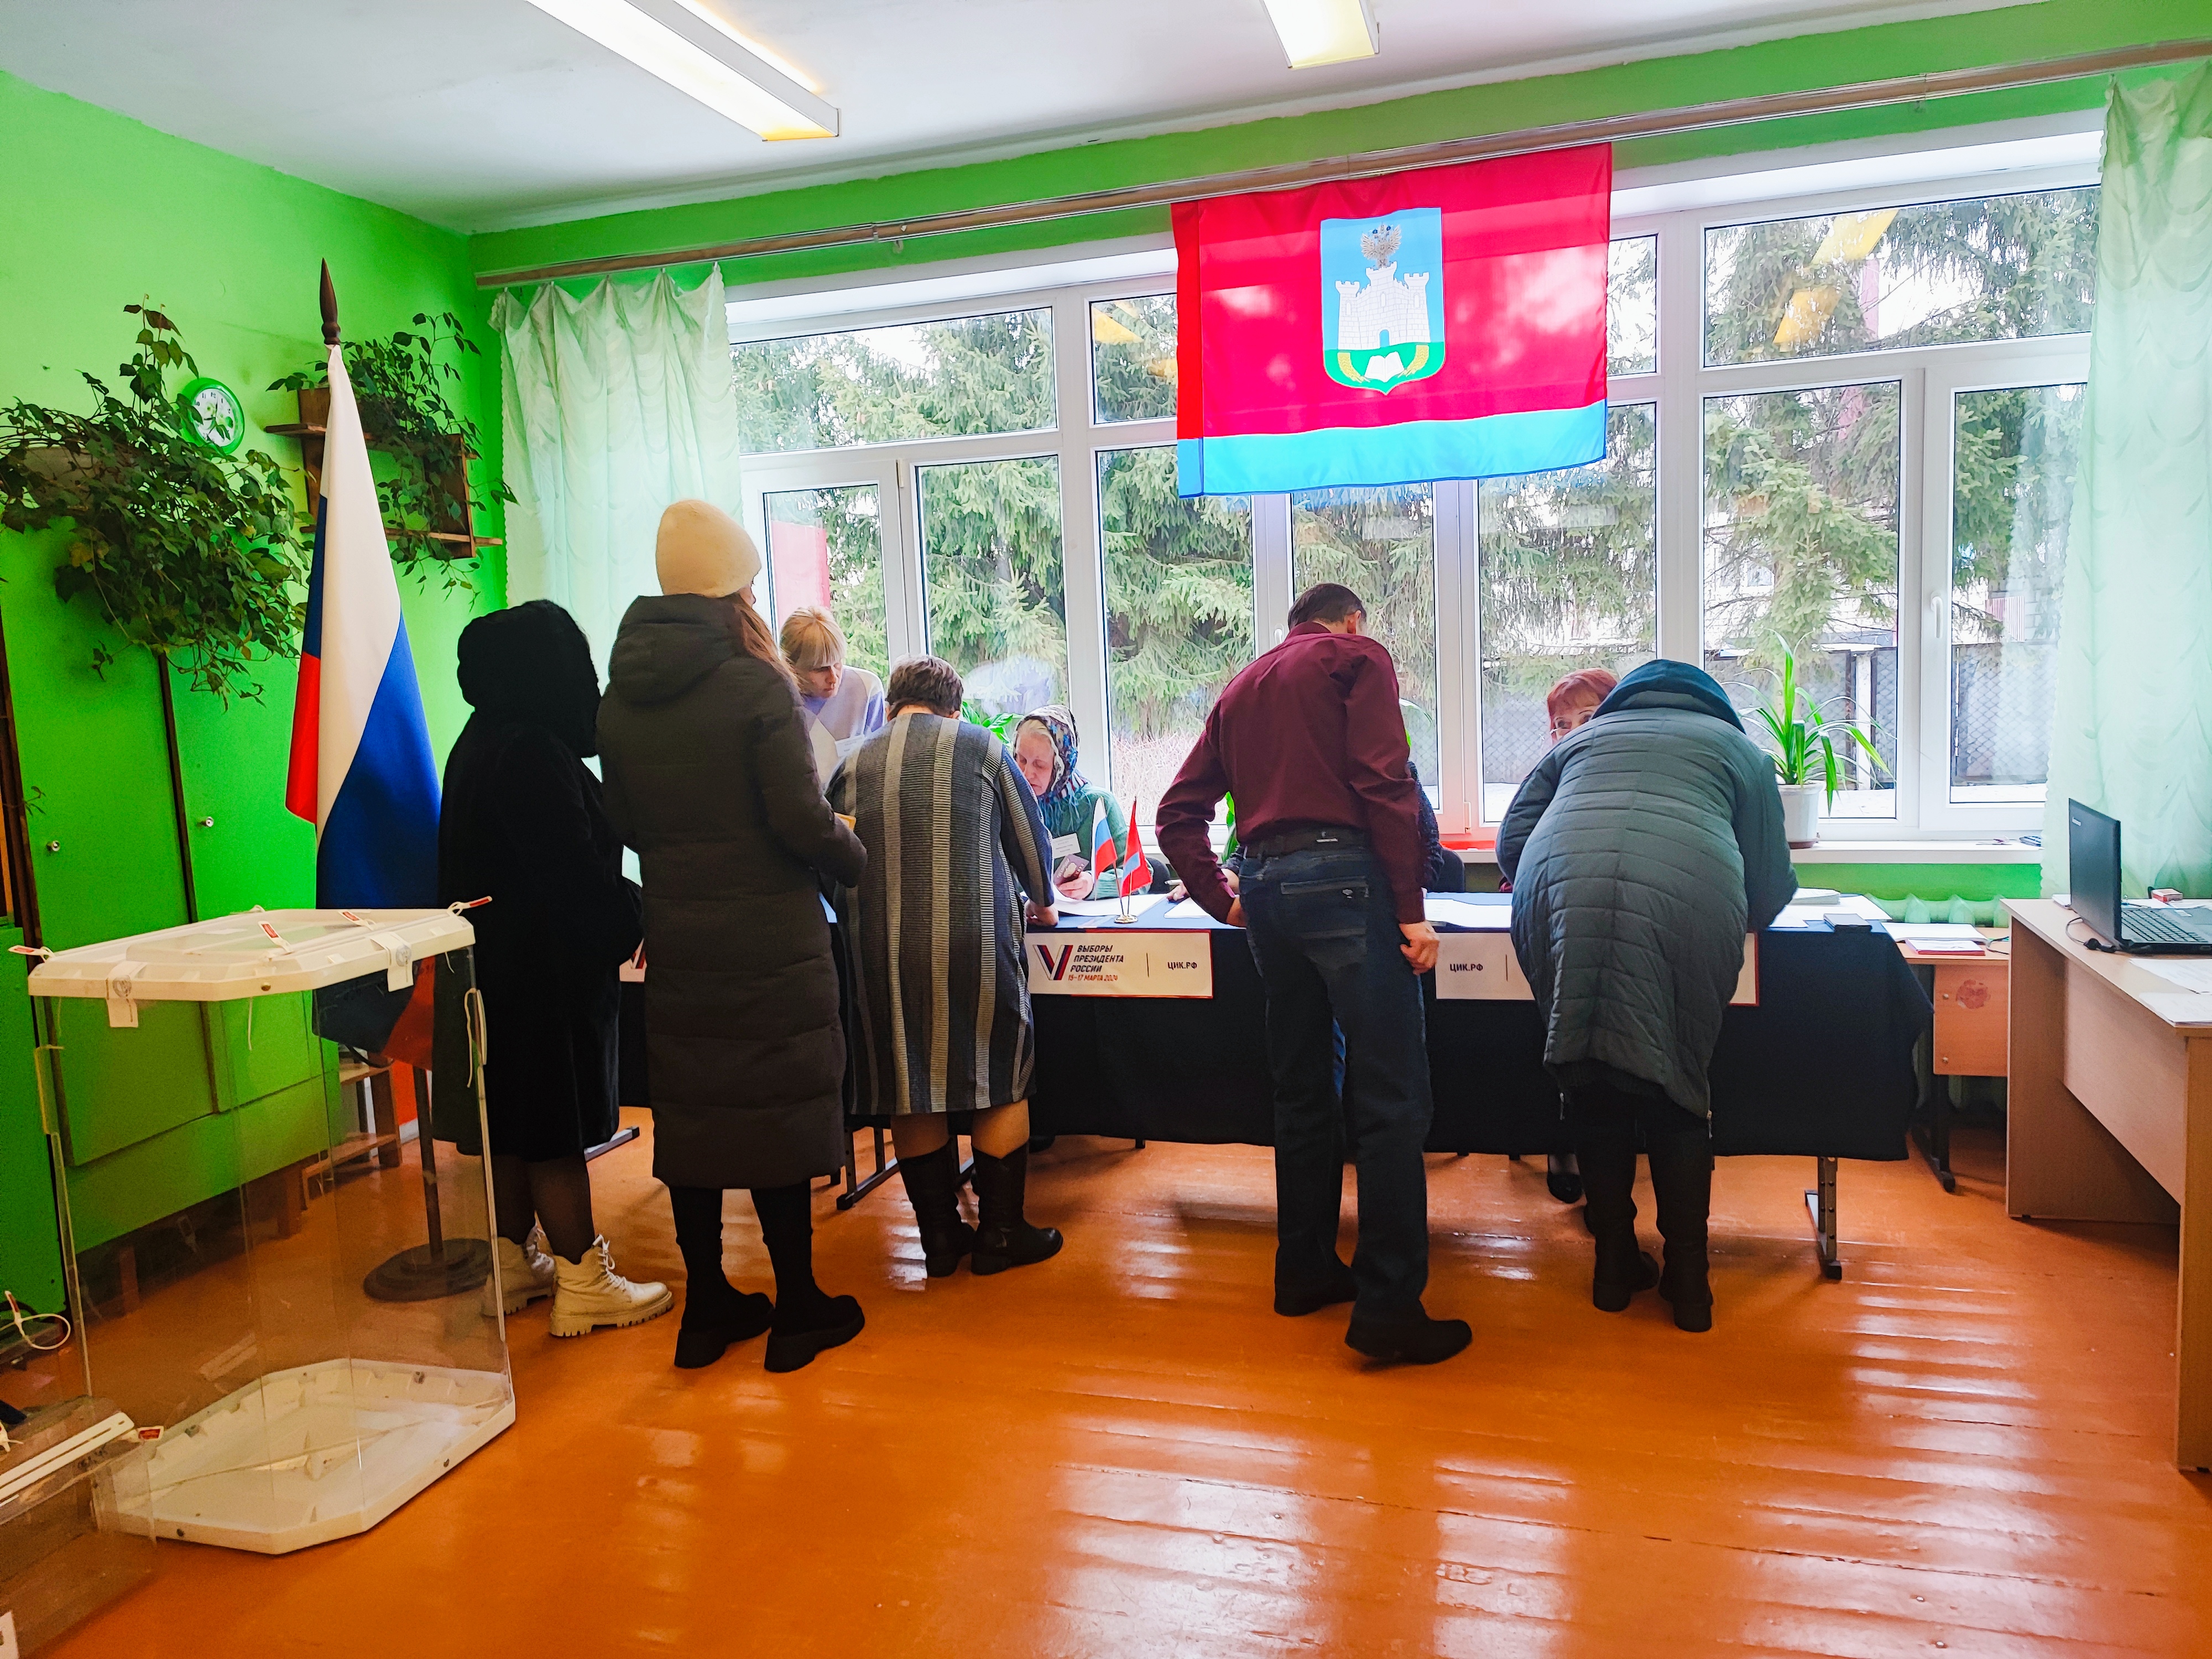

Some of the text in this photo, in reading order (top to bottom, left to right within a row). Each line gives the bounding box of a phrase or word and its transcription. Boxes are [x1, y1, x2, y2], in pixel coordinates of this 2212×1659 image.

[1073, 954, 1124, 963] ПРЕЗИДЕНТА
[1167, 961, 1197, 971] ЦИК.РФ
[1449, 963, 1483, 973] ЦИК.РФ
